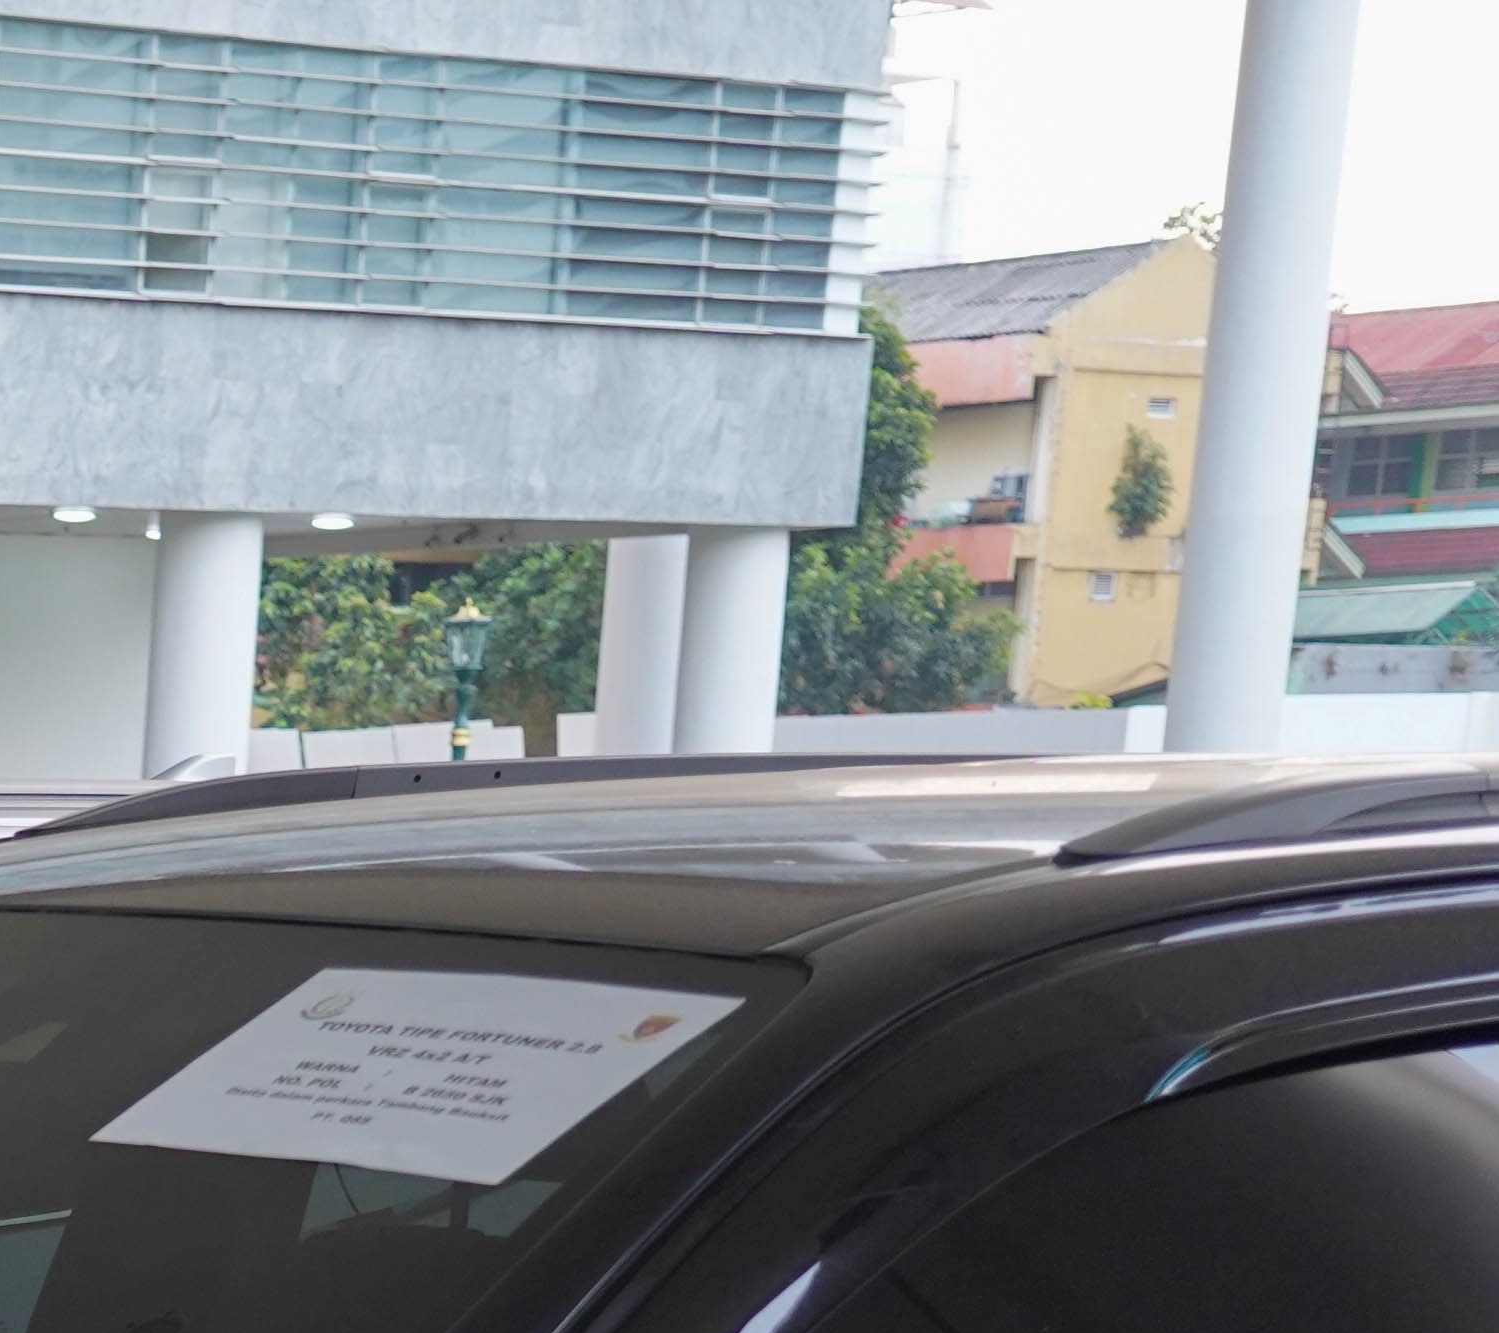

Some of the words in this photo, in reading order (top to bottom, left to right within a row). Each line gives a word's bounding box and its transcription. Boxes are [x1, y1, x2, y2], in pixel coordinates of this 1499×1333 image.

[318, 1020, 394, 1036] TOYOTA
[399, 1025, 445, 1040] TIPE
[446, 1029, 566, 1052] FORTUNER
[367, 1045, 411, 1059] VRZ
[295, 1060, 361, 1074] WARNA
[443, 1073, 508, 1089] HITAM
